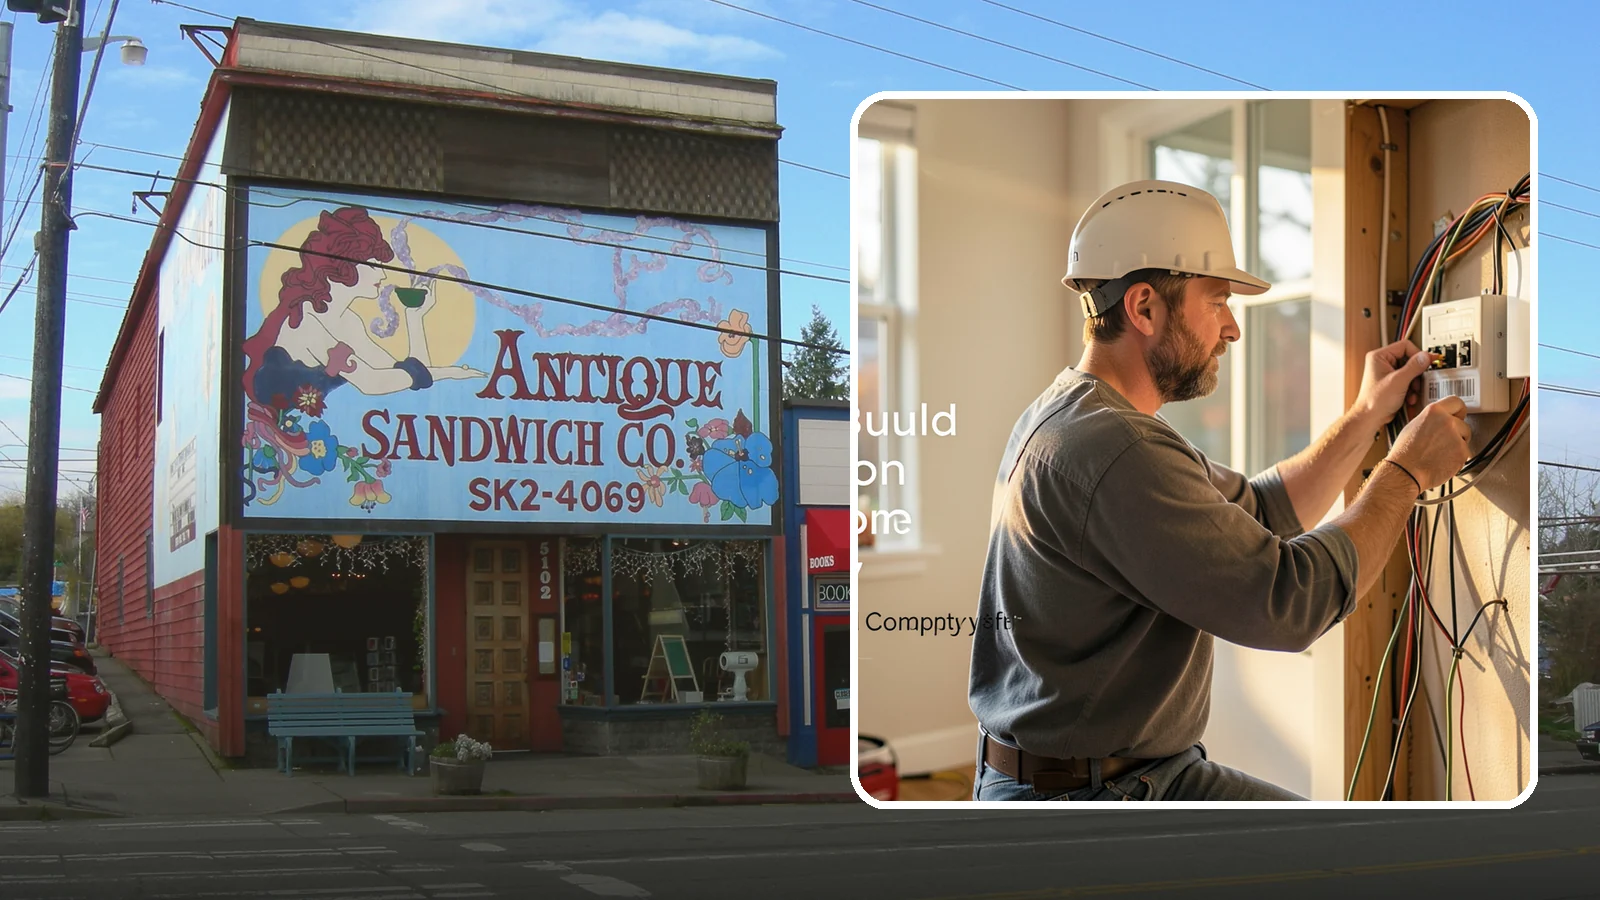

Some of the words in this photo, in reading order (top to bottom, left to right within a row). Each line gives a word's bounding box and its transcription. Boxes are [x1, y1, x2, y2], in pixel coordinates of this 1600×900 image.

[475, 329, 724, 421] ANTIQUE
[361, 408, 605, 468] SANDWICH
[617, 421, 685, 469] CO.
[468, 477, 646, 513] SK2-4069
[539, 542, 551, 599] 5102
[809, 555, 835, 568] BOOKS
